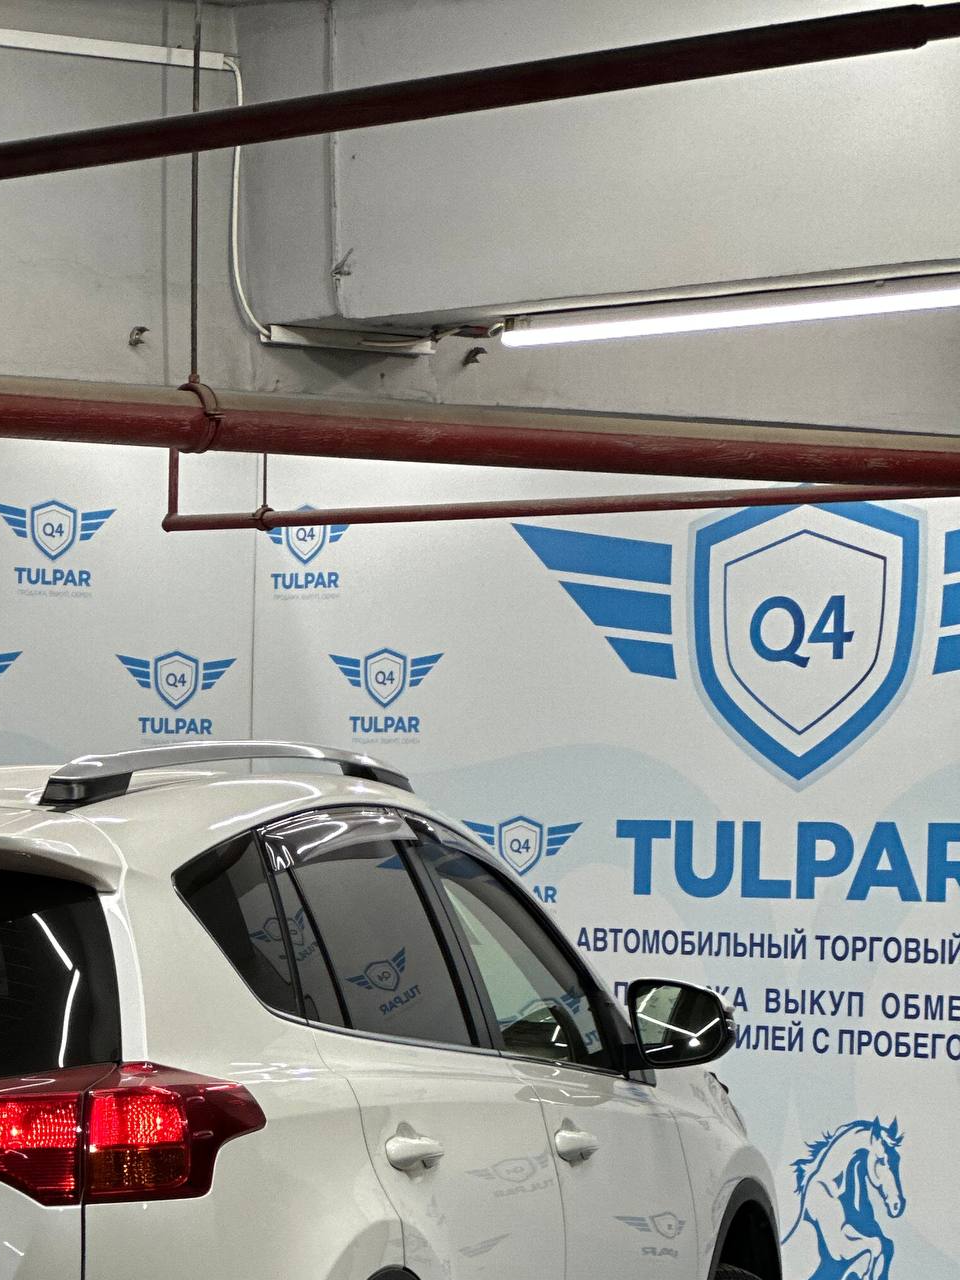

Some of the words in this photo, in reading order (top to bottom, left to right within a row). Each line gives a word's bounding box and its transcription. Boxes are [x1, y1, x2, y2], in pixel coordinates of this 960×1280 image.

[42, 523, 64, 538] Q4
[295, 527, 315, 542] Q4
[14, 566, 91, 587] TULPAR
[270, 572, 340, 589] TULPAR
[748, 594, 855, 669] Q4
[165, 673, 186, 688] Q4
[375, 670, 395, 686] Q4
[138, 717, 212, 734] TULPAR
[349, 716, 420, 733] TULPAR
[509, 838, 531, 854] Q4
[616, 819, 960, 903] TULPAR
[577, 927, 807, 960] АВТОМОБИЛЬНЫЙ
[815, 934, 960, 965] ТОРГОВЫЙ
[765, 987, 864, 1018] ВЫКУП
[735, 1021, 804, 1052] ИЛЕЙ
[812, 1029, 830, 1054] С
[838, 1029, 960, 1061] ПРОБЕГО
